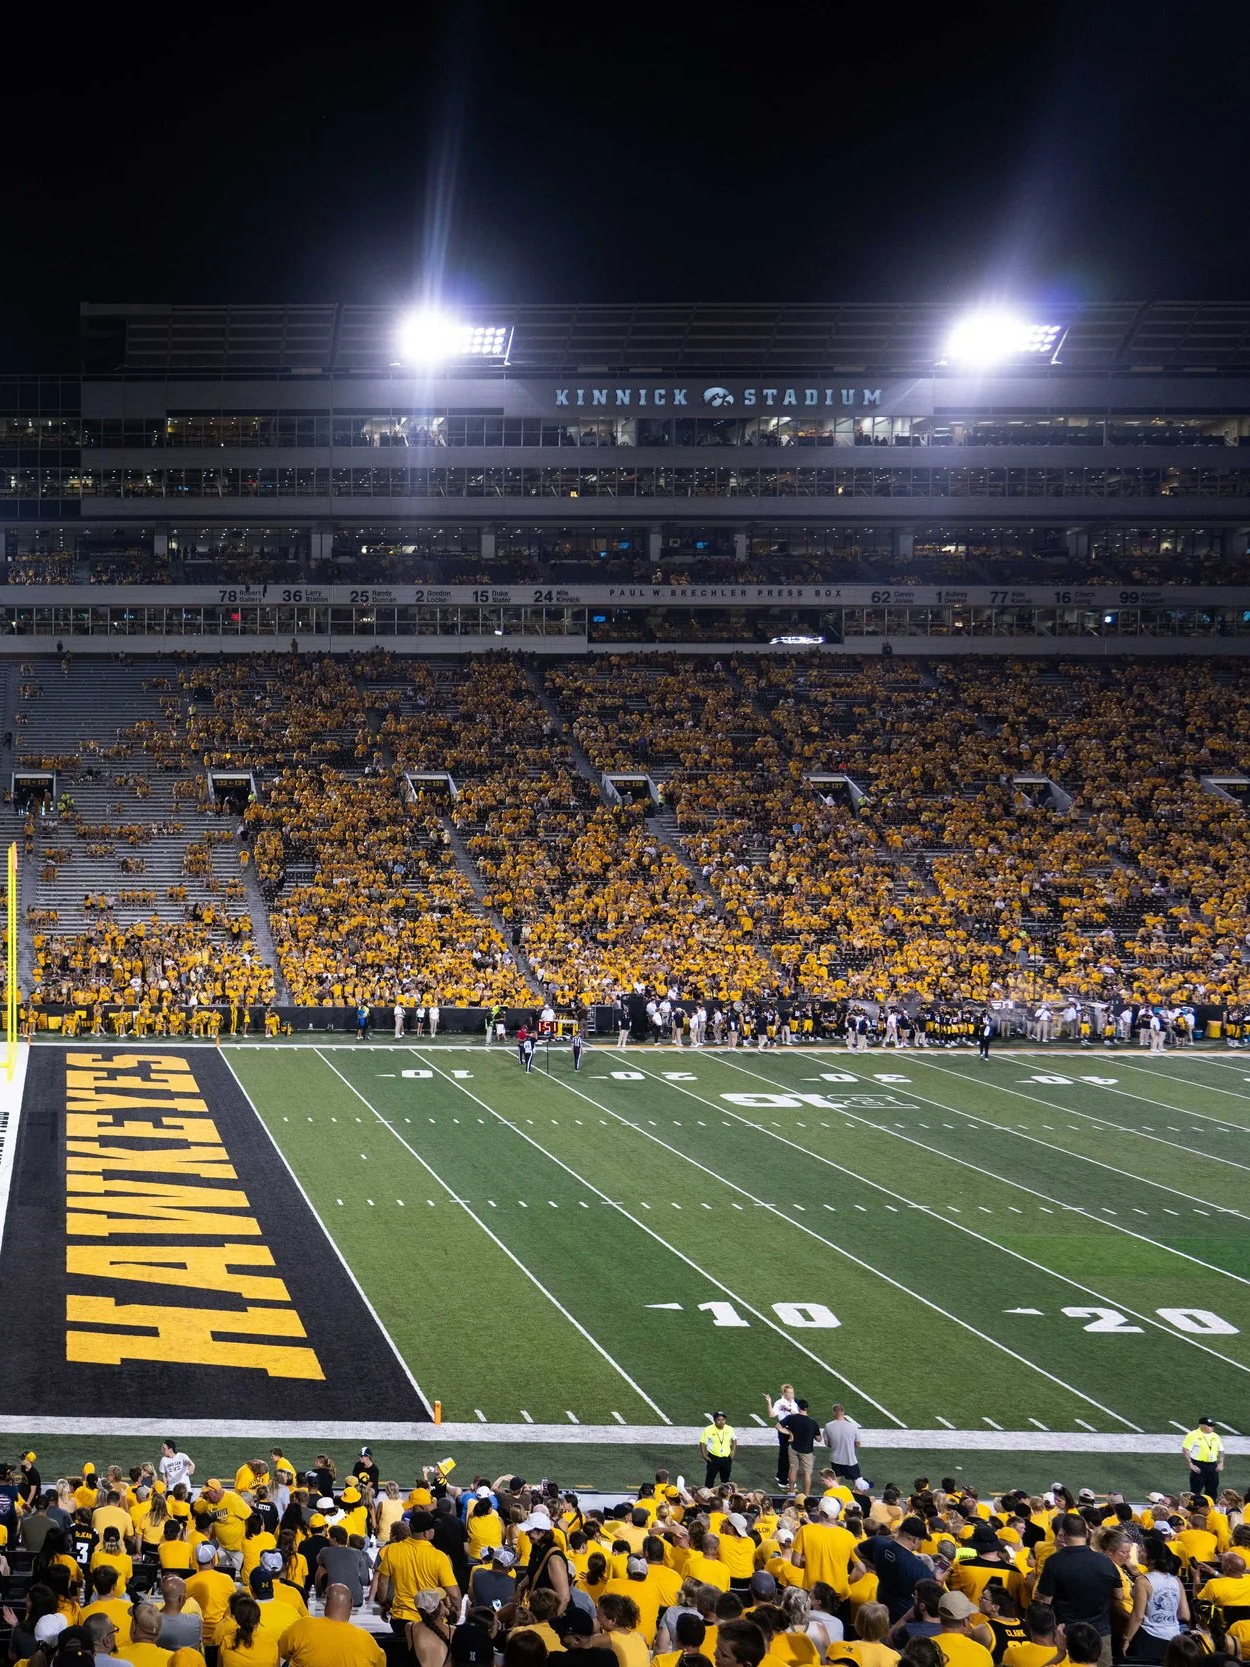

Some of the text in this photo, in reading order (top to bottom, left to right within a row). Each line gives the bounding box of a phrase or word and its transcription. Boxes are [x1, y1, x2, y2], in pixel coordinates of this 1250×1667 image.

[555, 388, 882, 406] KINNICK STADIUM
[219, 590, 237, 602] 78
[282, 590, 301, 602] 36
[350, 590, 369, 602] 25
[415, 590, 424, 602] 2
[472, 590, 489, 602] 15
[534, 590, 553, 602] 24
[609, 589, 645, 597] PAUL
[671, 589, 747, 597] BRECHLER
[758, 589, 803, 597] PRESS
[815, 589, 842, 597] BOX
[871, 591, 890, 603] 62
[936, 591, 942, 603] 1
[990, 591, 1008, 603] 77
[1054, 591, 1071, 603] 16
[1119, 591, 1139, 603] 99
[66, 1053, 326, 1380] HAWKEYES
[697, 1301, 842, 1328] 10
[1060, 1306, 1240, 1334] 20
[76, 1542, 89, 1564] 3
[1005, 1629, 1026, 1637] CLARK
